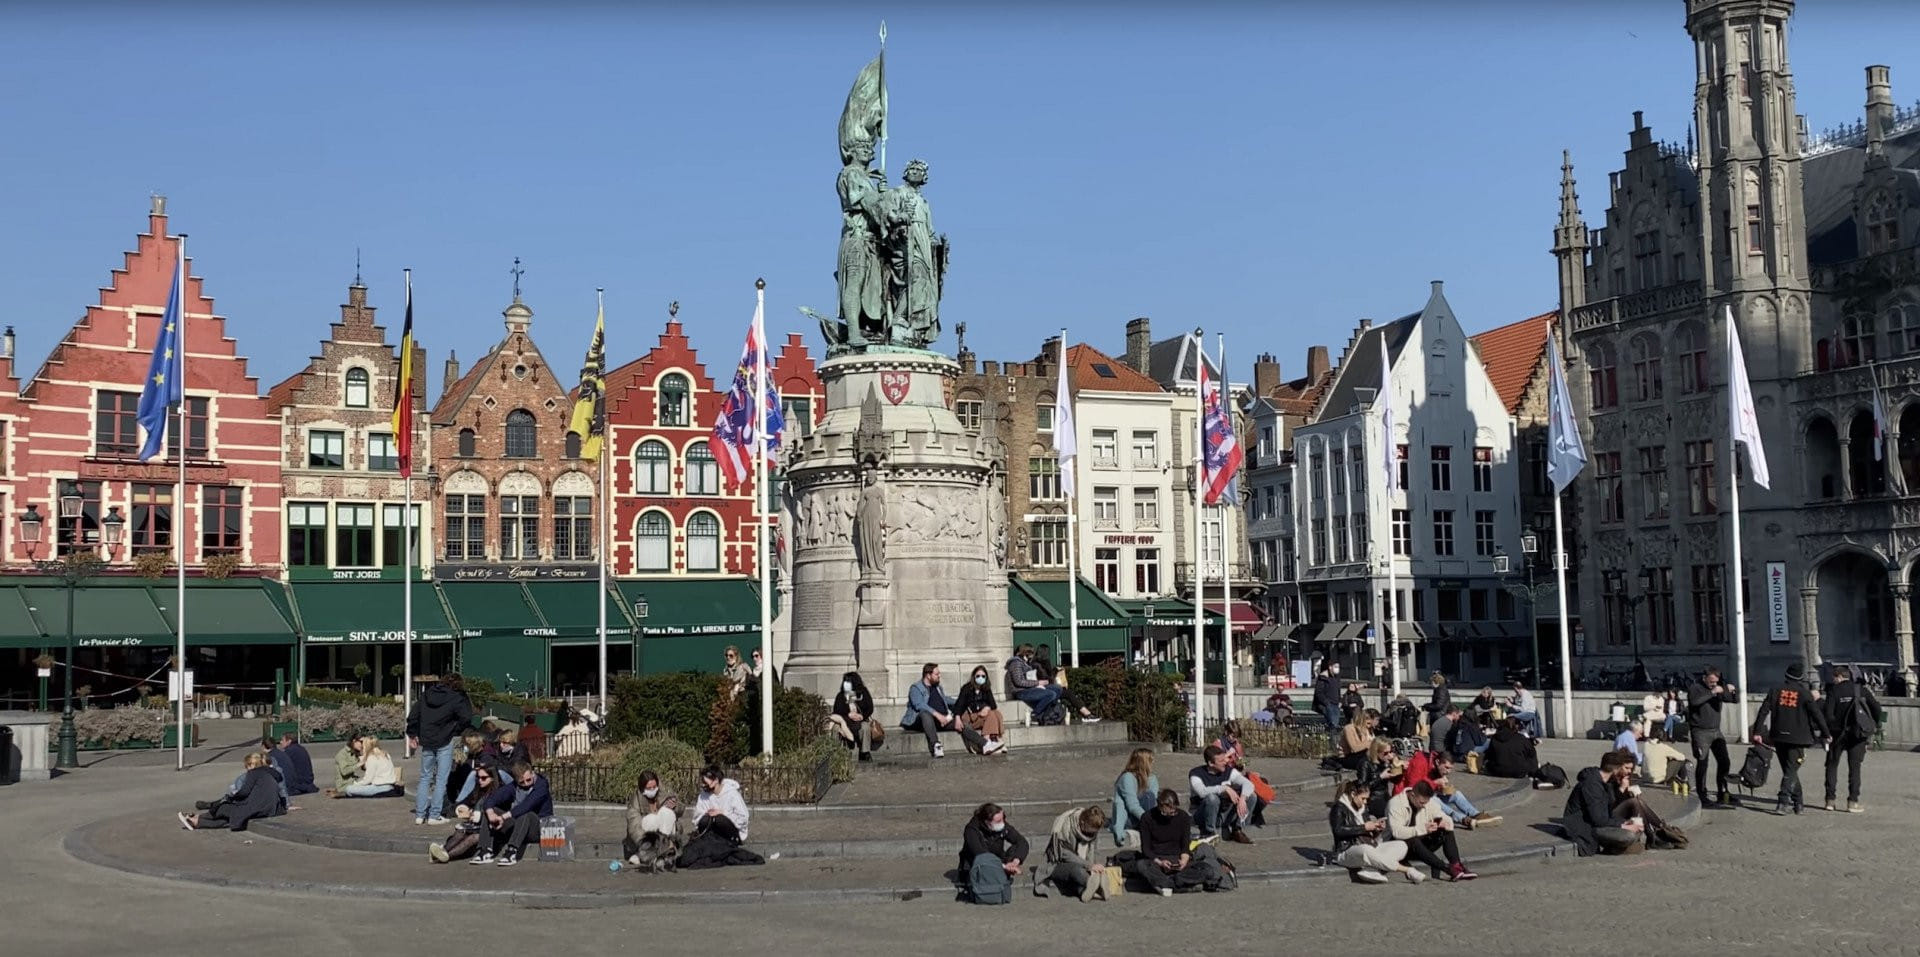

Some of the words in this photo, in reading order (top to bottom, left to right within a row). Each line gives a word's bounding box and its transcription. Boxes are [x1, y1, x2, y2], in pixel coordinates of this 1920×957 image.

[86, 464, 109, 477] LE
[333, 571, 353, 579] SINT
[356, 571, 382, 579] JORIS
[1773, 577, 1784, 635] HISTORIUM
[1096, 618, 1116, 626] CAFE
[463, 629, 482, 637] Hotel
[523, 628, 558, 636] CENTRAL
[643, 627, 660, 635] Pasta
[702, 625, 727, 633] SIRENE
[349, 631, 418, 641] SINT-JORS
[79, 638, 90, 646] Le
[90, 638, 121, 646] Panier
